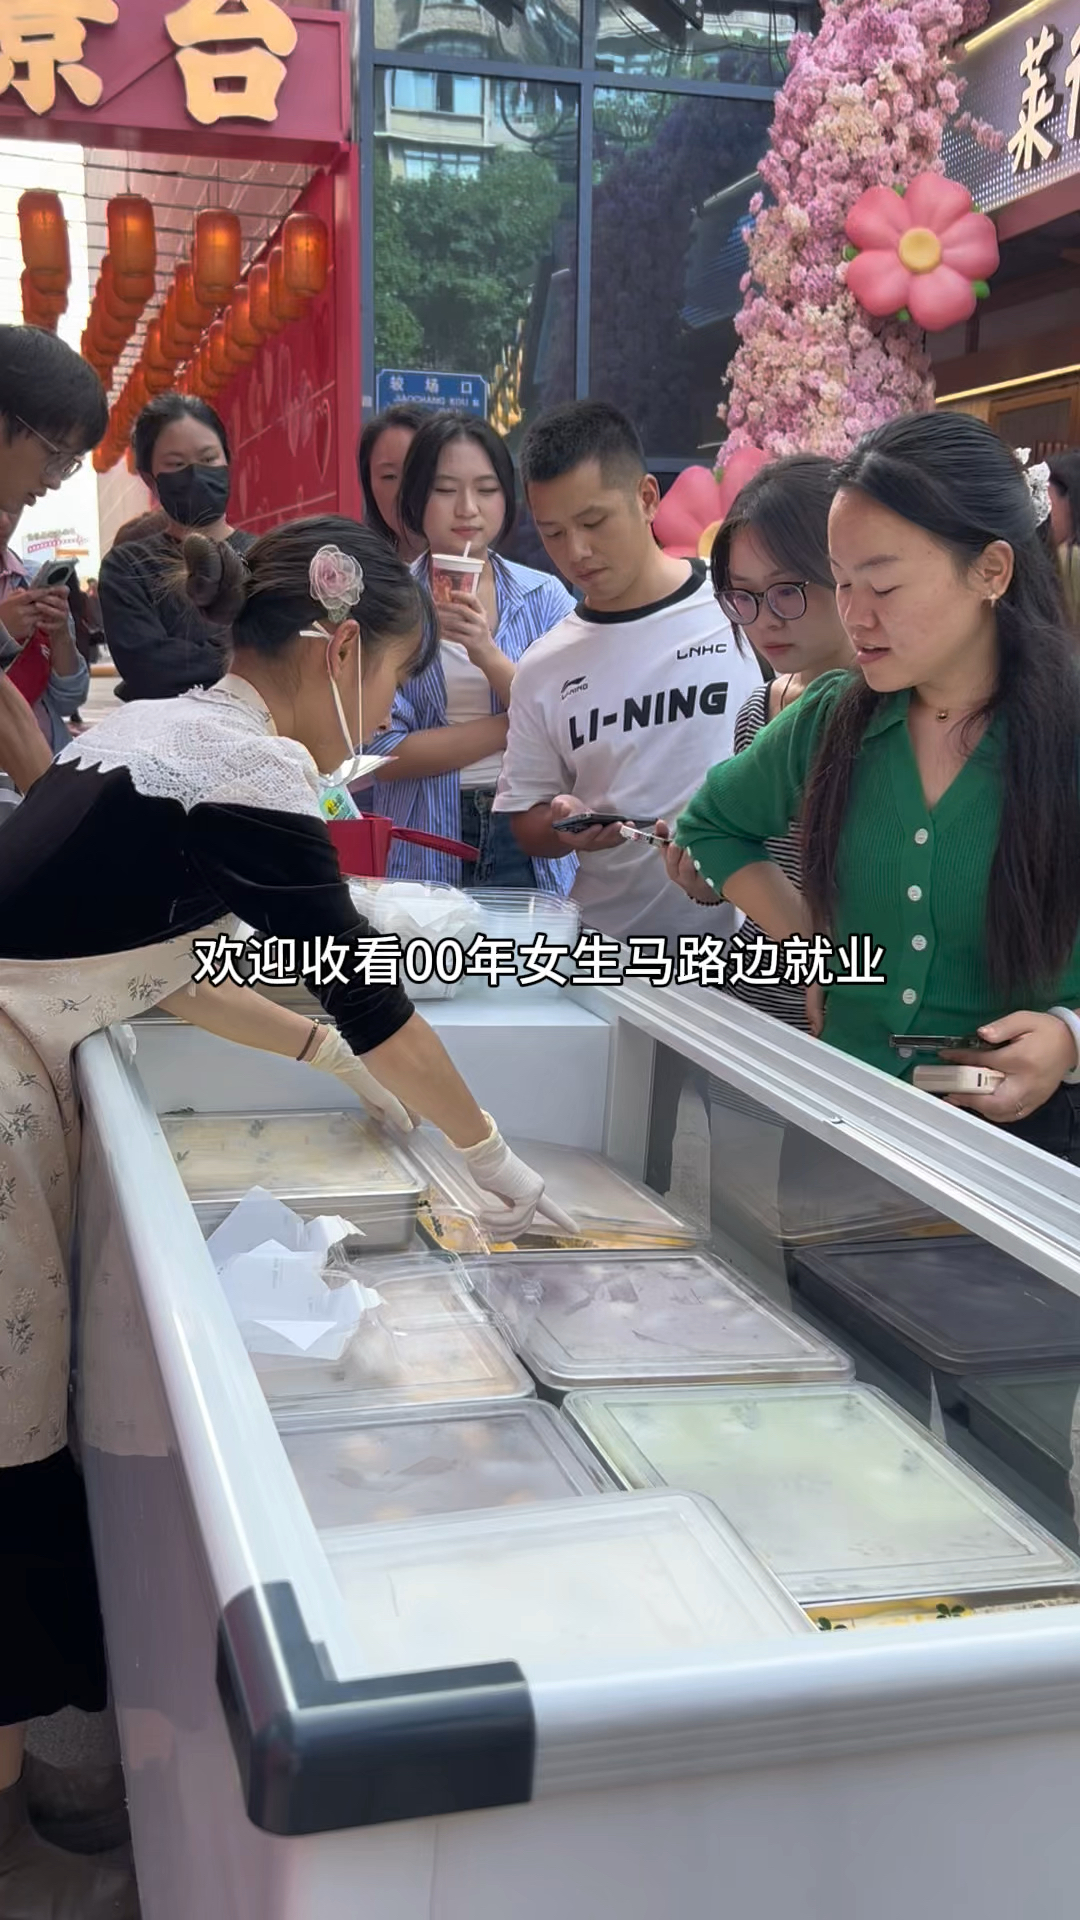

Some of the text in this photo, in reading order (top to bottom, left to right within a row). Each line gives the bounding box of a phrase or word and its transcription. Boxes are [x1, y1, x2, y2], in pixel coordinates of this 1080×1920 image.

[389, 375, 473, 395] 较场口
[676, 643, 727, 660] LNHC
[561, 682, 589, 701] LI-NING
[569, 682, 729, 751] LI-NING
